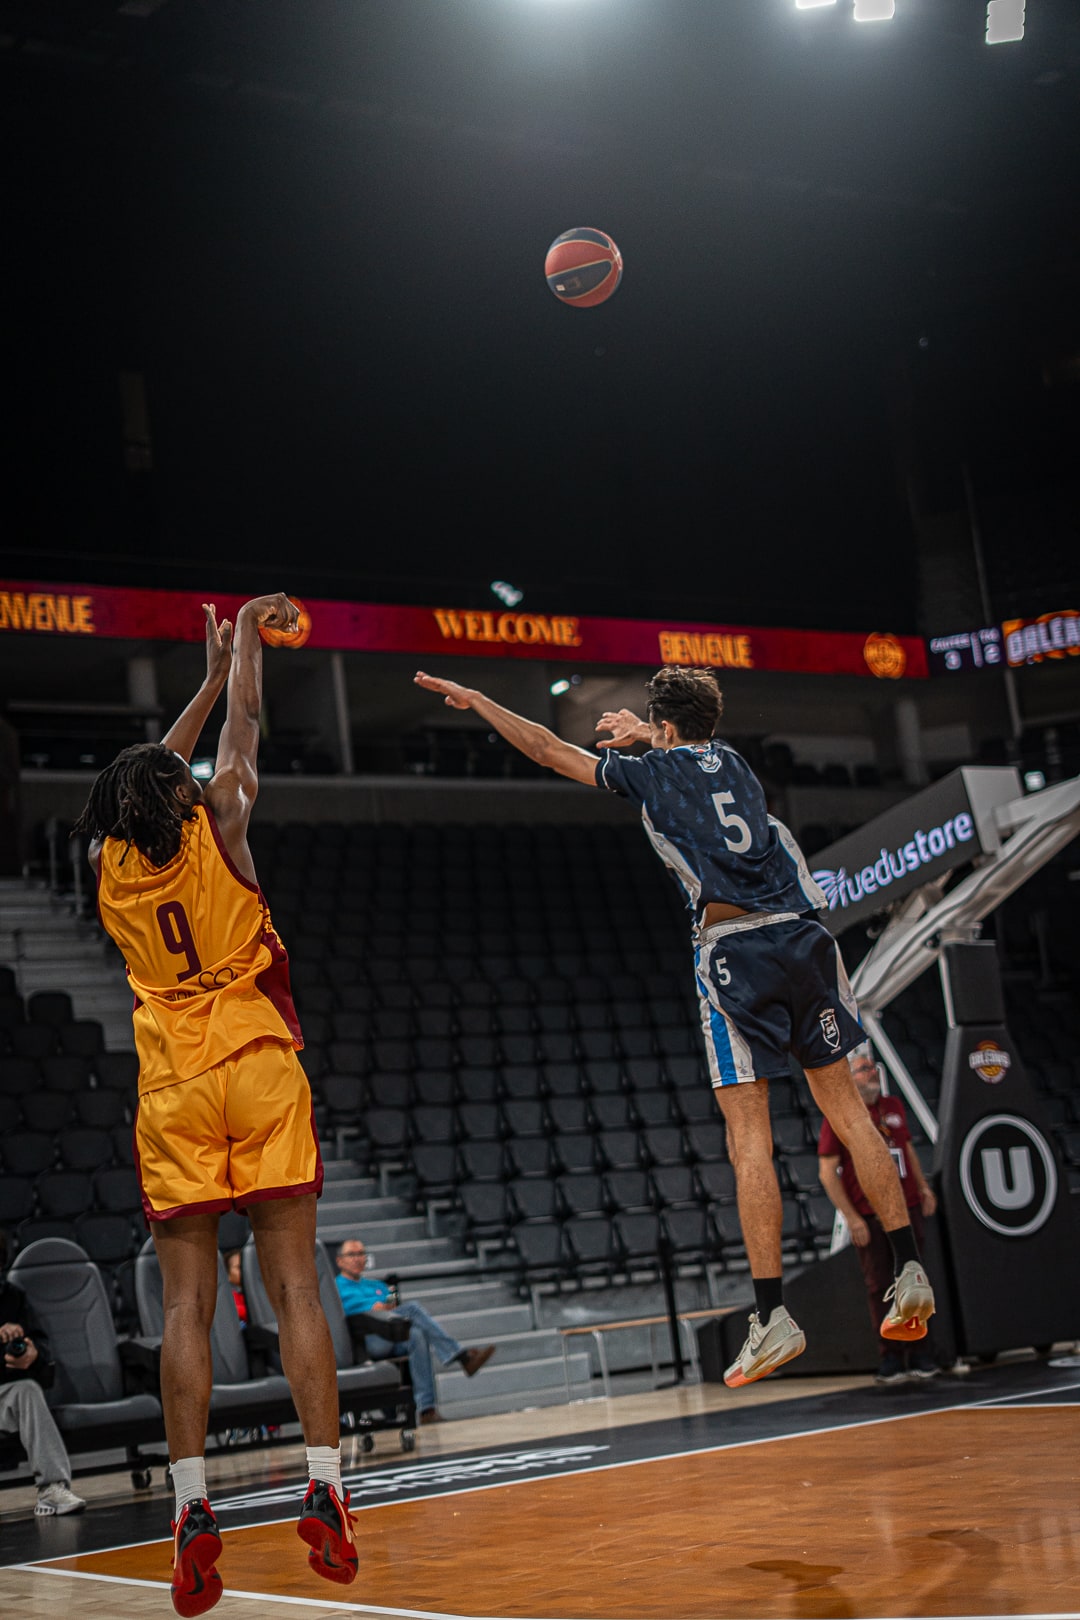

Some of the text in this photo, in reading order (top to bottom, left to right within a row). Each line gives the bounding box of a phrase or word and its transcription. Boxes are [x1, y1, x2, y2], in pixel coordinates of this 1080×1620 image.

[0, 591, 95, 633] NVENUE
[433, 608, 583, 647] WELCOME
[658, 631, 754, 669] BIENVENUE
[711, 790, 753, 854] 5
[155, 901, 203, 982] 9
[715, 956, 733, 986] 5
[980, 1145, 1036, 1211] U
